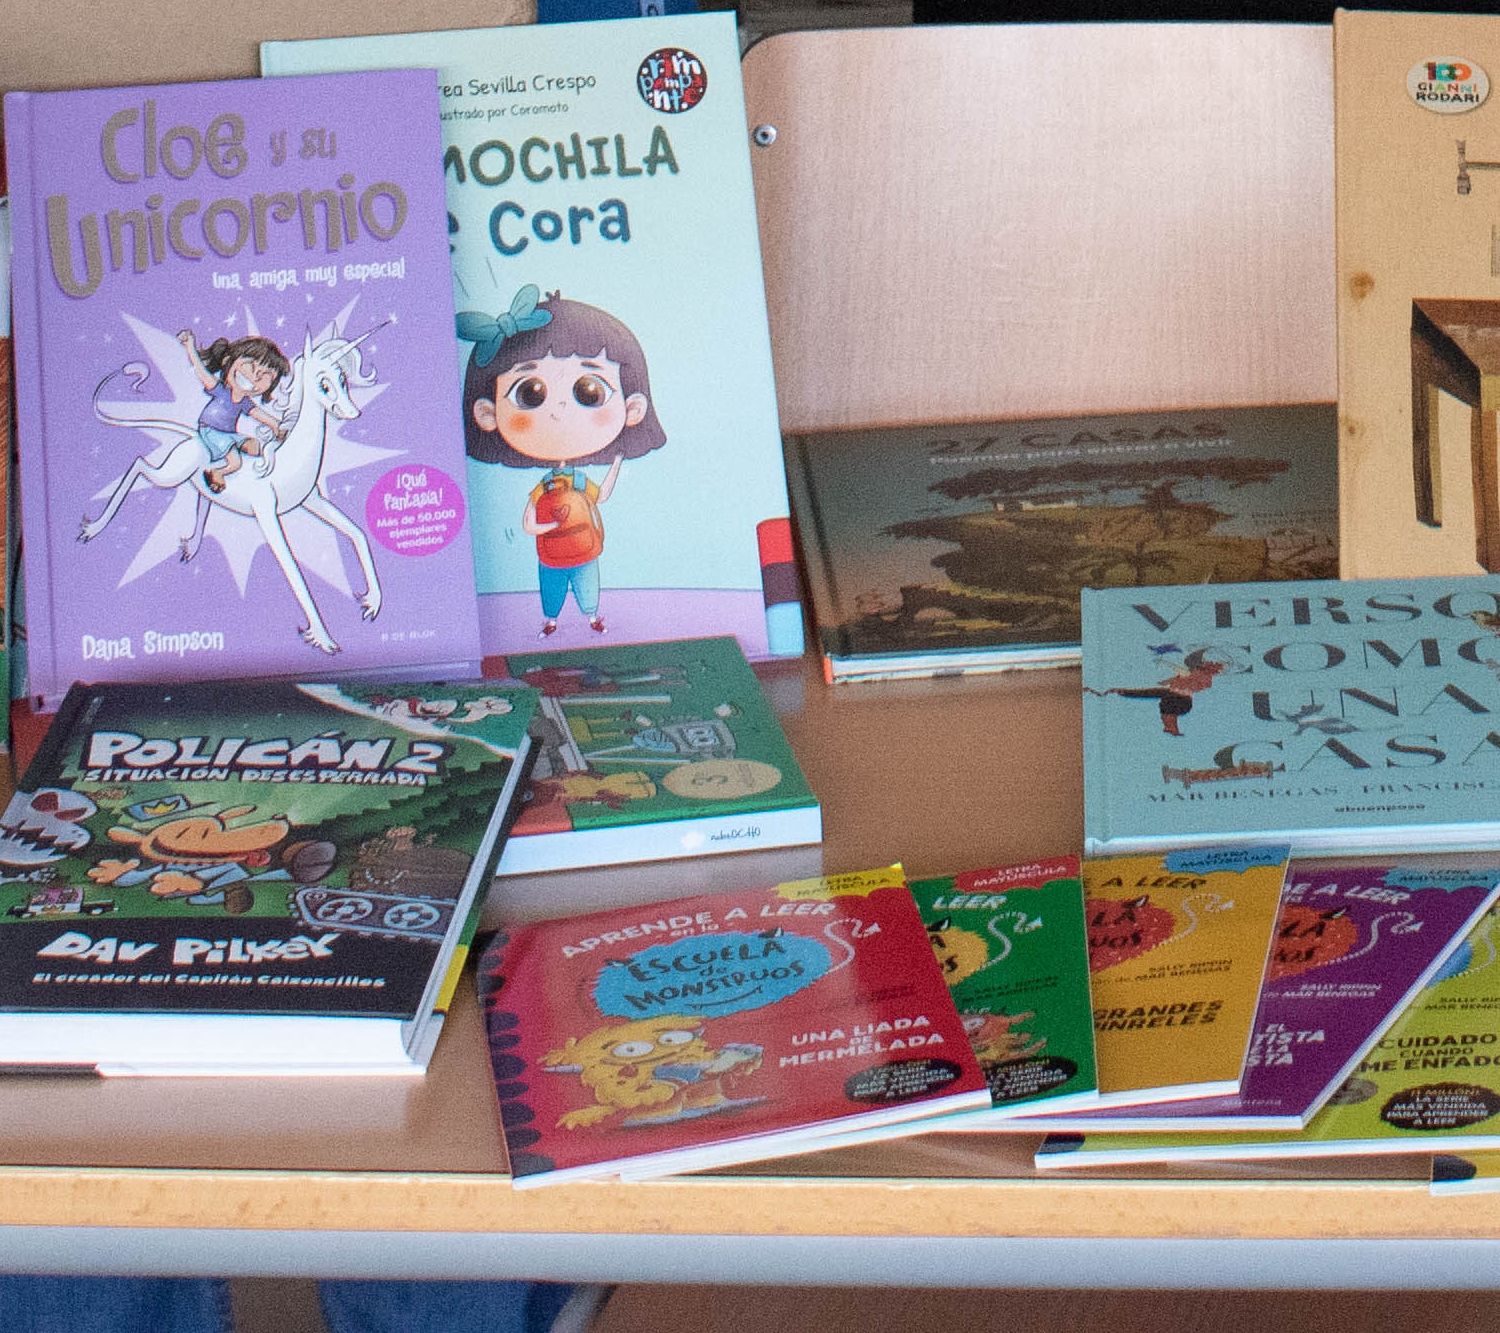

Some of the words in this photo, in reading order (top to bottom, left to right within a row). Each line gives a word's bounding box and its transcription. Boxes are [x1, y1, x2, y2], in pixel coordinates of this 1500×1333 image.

[468, 75, 527, 97] Sevilla
[532, 74, 597, 96] Crespo
[1416, 82, 1478, 95] GIANNI
[1414, 91, 1481, 105] RODARI
[486, 108, 506, 123] por
[101, 99, 249, 185] Cloe
[268, 127, 288, 166] y
[298, 125, 338, 160] su
[46, 172, 409, 300] Unicornio
[488, 197, 632, 257] Cora
[249, 266, 300, 293] amiga
[305, 266, 338, 288] muy
[343, 257, 406, 283] especial
[376, 516, 400, 528] Más
[389, 522, 448, 541] ejemplares
[396, 534, 444, 549] vendidos
[81, 633, 136, 661] Dana
[143, 629, 225, 660] Simpson
[1251, 683, 1492, 723] UNA
[86, 731, 393, 770] POLICÁN
[395, 740, 446, 774] 2
[84, 766, 231, 784] SITUACIÓN
[1148, 789, 1205, 803] MAR
[1213, 782, 1340, 801] BENEGAS
[1133, 874, 1209, 890] LEER
[931, 894, 1008, 911] LEER
[1343, 886, 1411, 905] LEER
[562, 911, 713, 959] APRENDE
[724, 906, 749, 920] A
[760, 902, 837, 918] LEER
[627, 936, 785, 983] ESCUELA
[32, 972, 53, 985] El
[54, 972, 134, 986] creador
[138, 972, 171, 985] del
[174, 971, 252, 987] Capitán
[256, 974, 387, 989] Calzoncillos
[622, 959, 806, 1012] MONSTRUOS
[791, 1029, 845, 1047] UNA
[853, 1015, 931, 1037] LIADA
[778, 1032, 945, 1069] MERMELADA
[1377, 1033, 1498, 1050] CUIDADO
[1399, 1047, 1474, 1058] CUANDO
[1360, 1060, 1400, 1073] ME
[1423, 1108, 1489, 1119] APRENDER
[1425, 1101, 1487, 1111] VENDIDA
